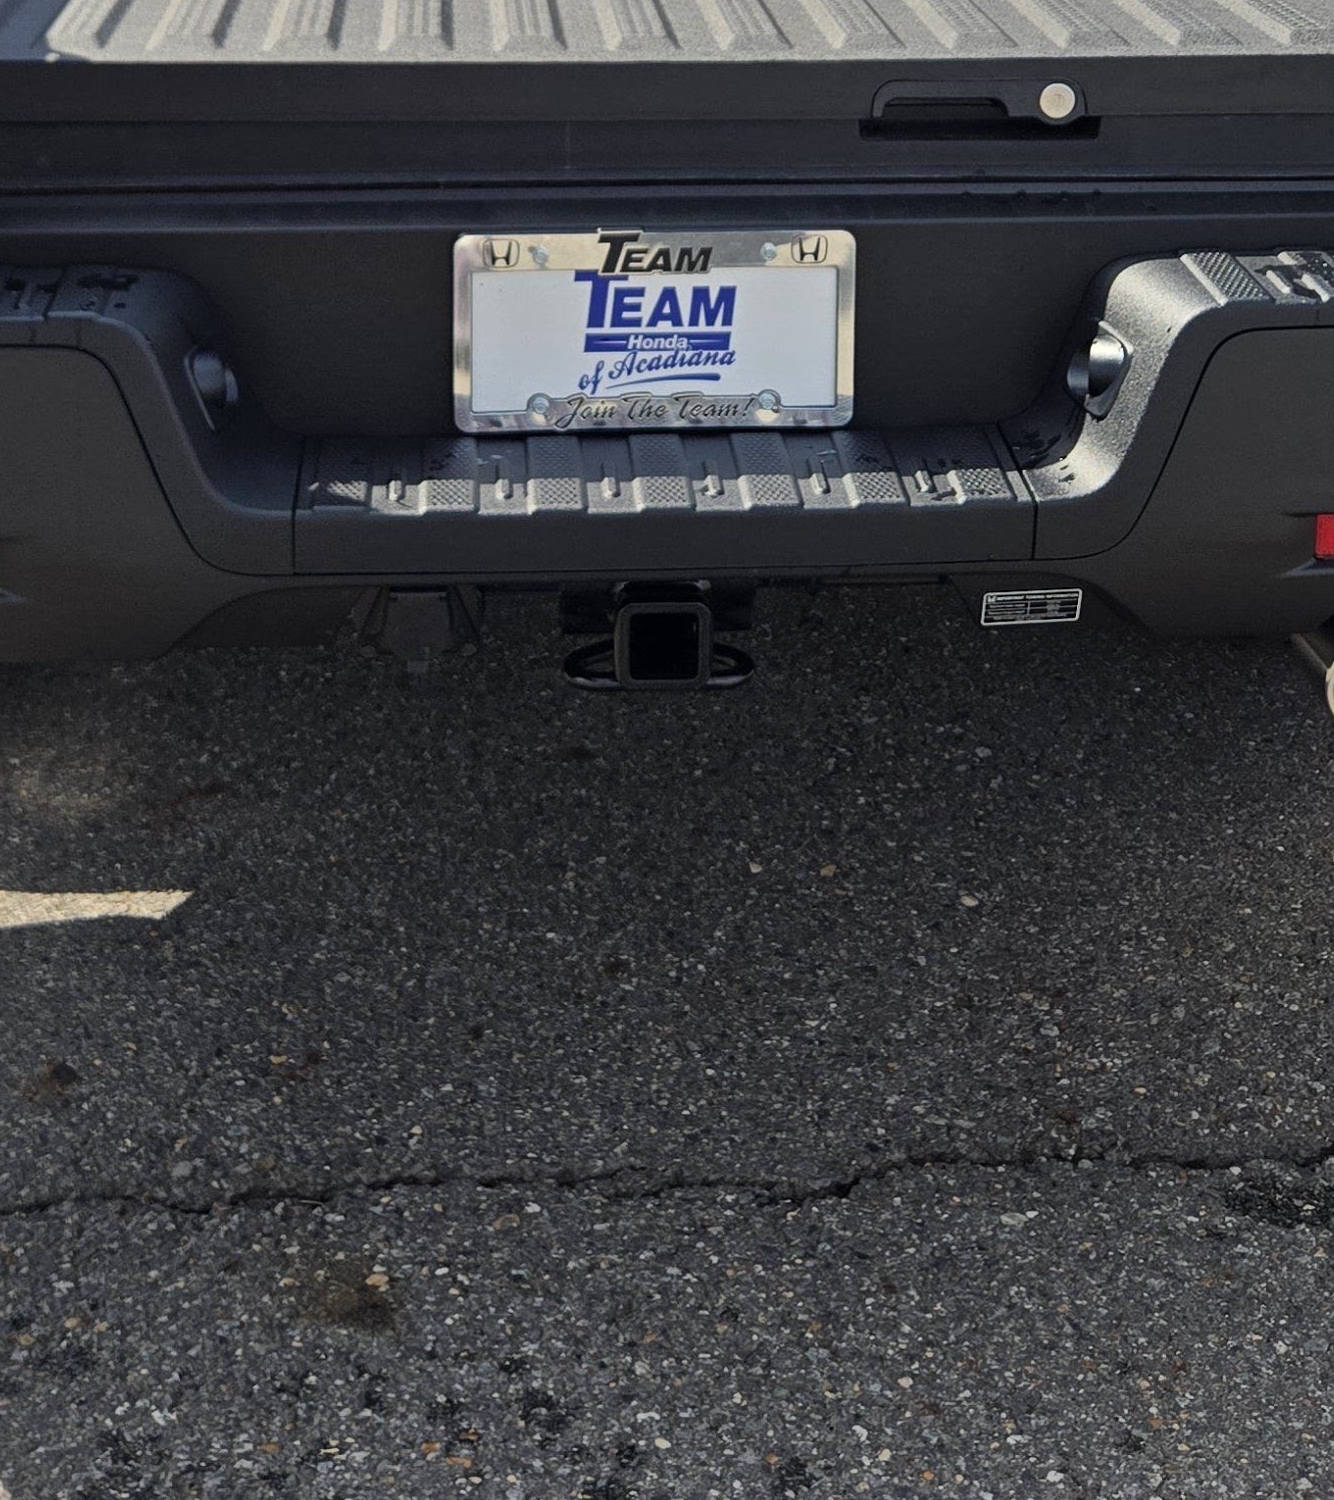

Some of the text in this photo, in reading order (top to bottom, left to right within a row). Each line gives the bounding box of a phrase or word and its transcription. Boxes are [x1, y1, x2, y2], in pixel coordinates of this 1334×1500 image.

[598, 232, 713, 274] TEAM
[574, 269, 737, 328] TEAM
[627, 333, 688, 350] Honda
[578, 347, 736, 395] of Acadiana
[554, 395, 754, 429] Join The Team!
